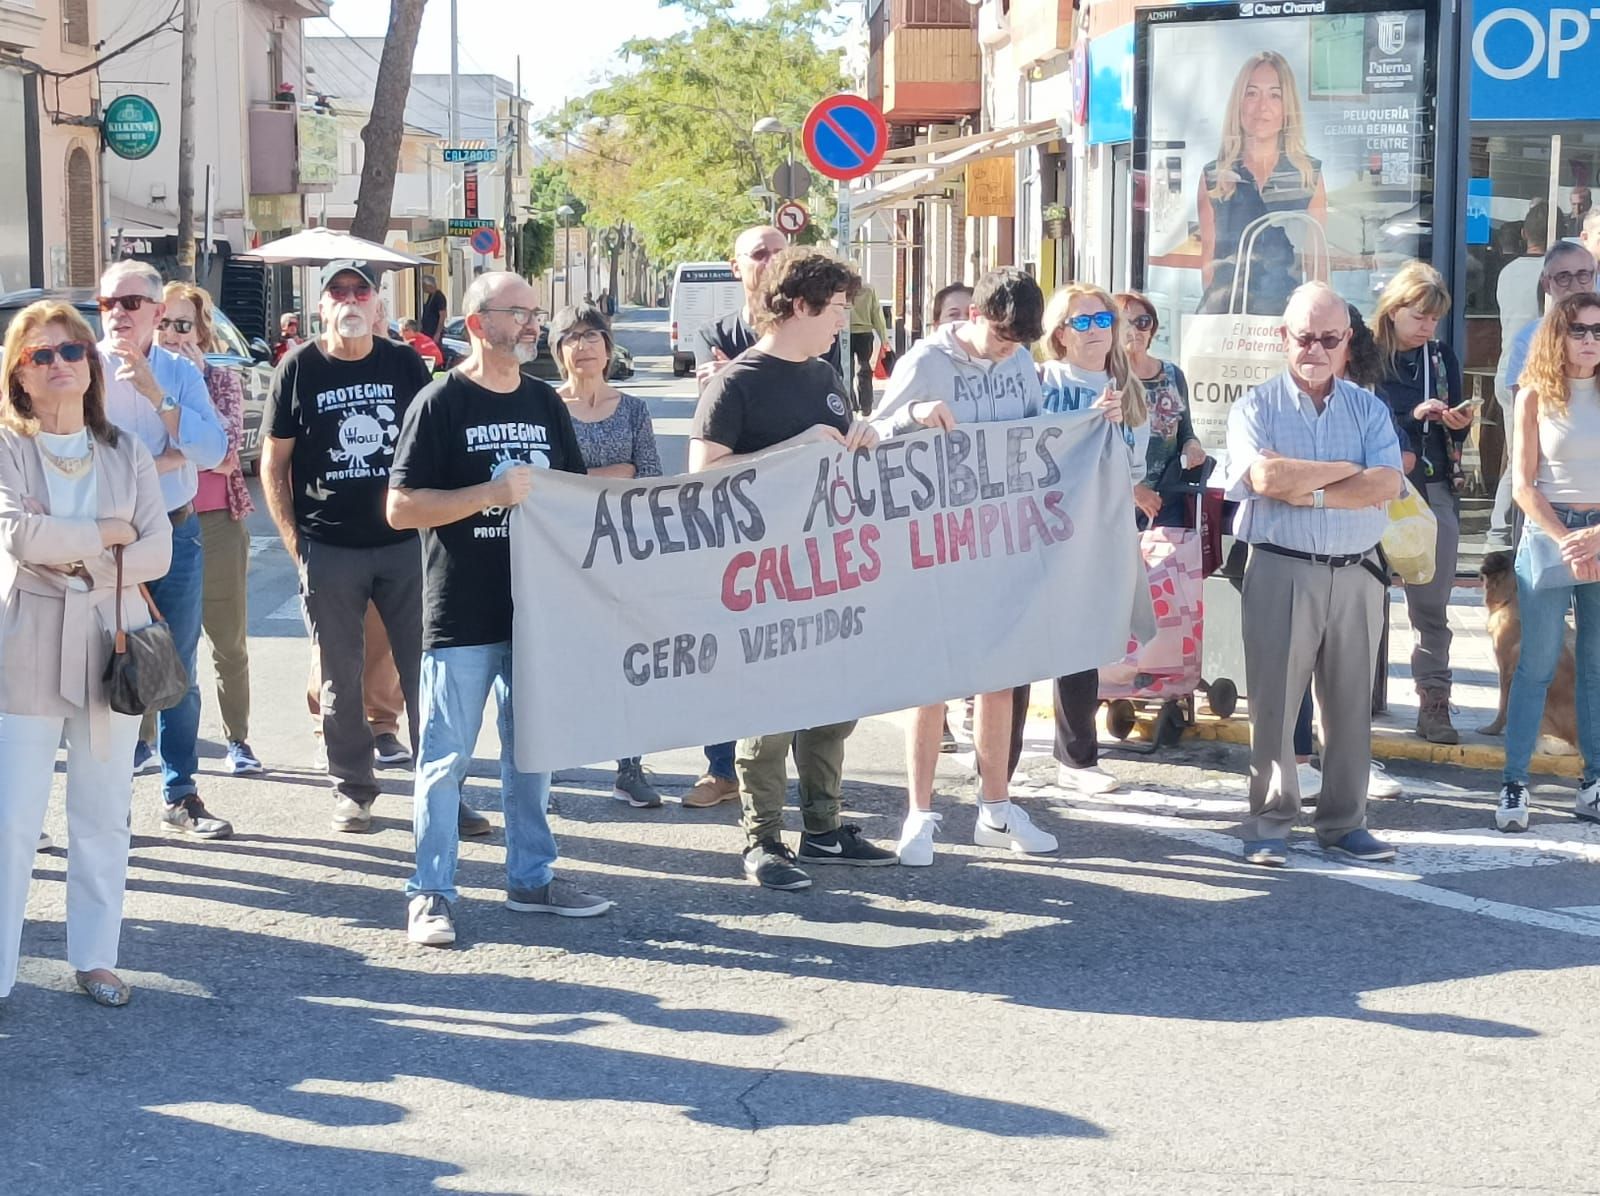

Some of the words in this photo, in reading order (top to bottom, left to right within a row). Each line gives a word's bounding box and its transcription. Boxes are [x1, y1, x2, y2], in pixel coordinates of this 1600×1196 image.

[1255, 3, 1281, 15] Clear
[1283, 1, 1325, 14] Channel
[1472, 7, 1600, 80] OP
[1369, 61, 1411, 73] Paterna
[1343, 105, 1409, 122] PELUQUERÍA
[1324, 124, 1364, 135] GEMMA
[1366, 123, 1409, 135] BERNAL
[1367, 138, 1409, 149] CENTRE
[444, 150, 497, 161] CALZADOS
[449, 228, 474, 236] PERFU
[1232, 322, 1244, 336] El
[1221, 365, 1238, 378] 25
[1244, 366, 1271, 379] OCT
[316, 383, 394, 408] PROTEGINT
[1193, 382, 1254, 403] COM
[465, 422, 547, 445] PROTEGINT
[372, 466, 386, 477] LA
[582, 468, 766, 569] ACERAS
[720, 523, 881, 611] CALLES
[909, 490, 1074, 569] LIMPIAS
[622, 633, 718, 687] CERO
[739, 606, 866, 664] VERTIDOS
